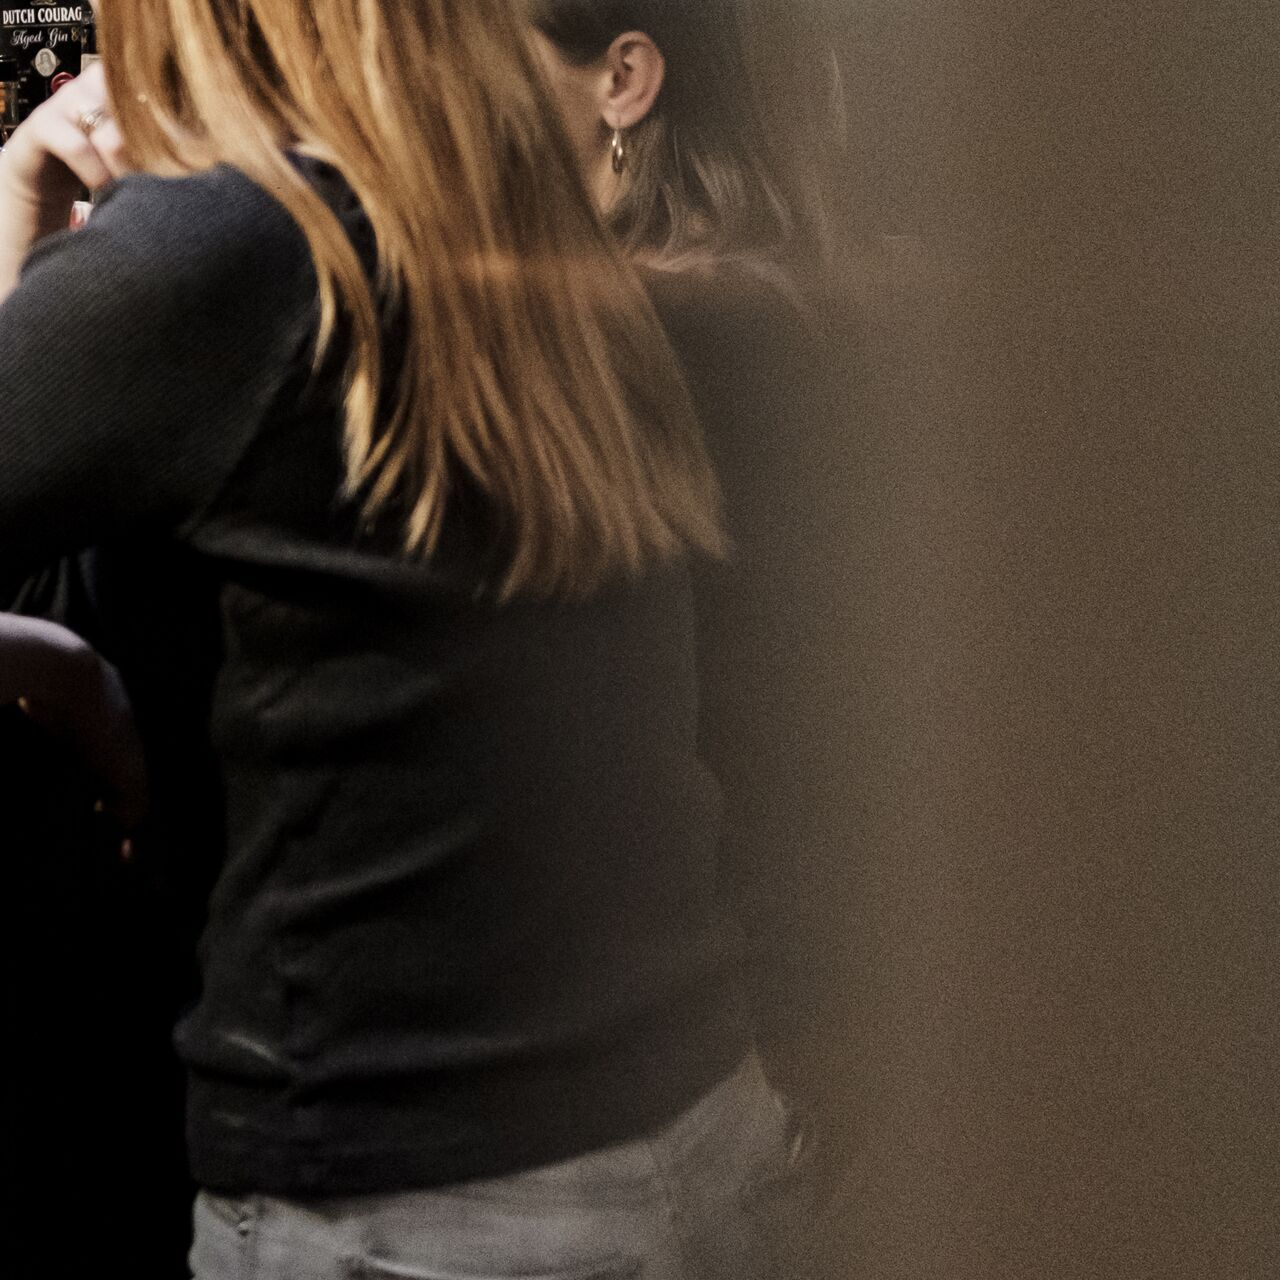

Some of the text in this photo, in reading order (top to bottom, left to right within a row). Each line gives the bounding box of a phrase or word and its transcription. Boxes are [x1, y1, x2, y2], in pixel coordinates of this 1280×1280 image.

[3, 9, 36, 25] DUTCH
[11, 28, 43, 49] Aged
[46, 27, 69, 48] Gin
